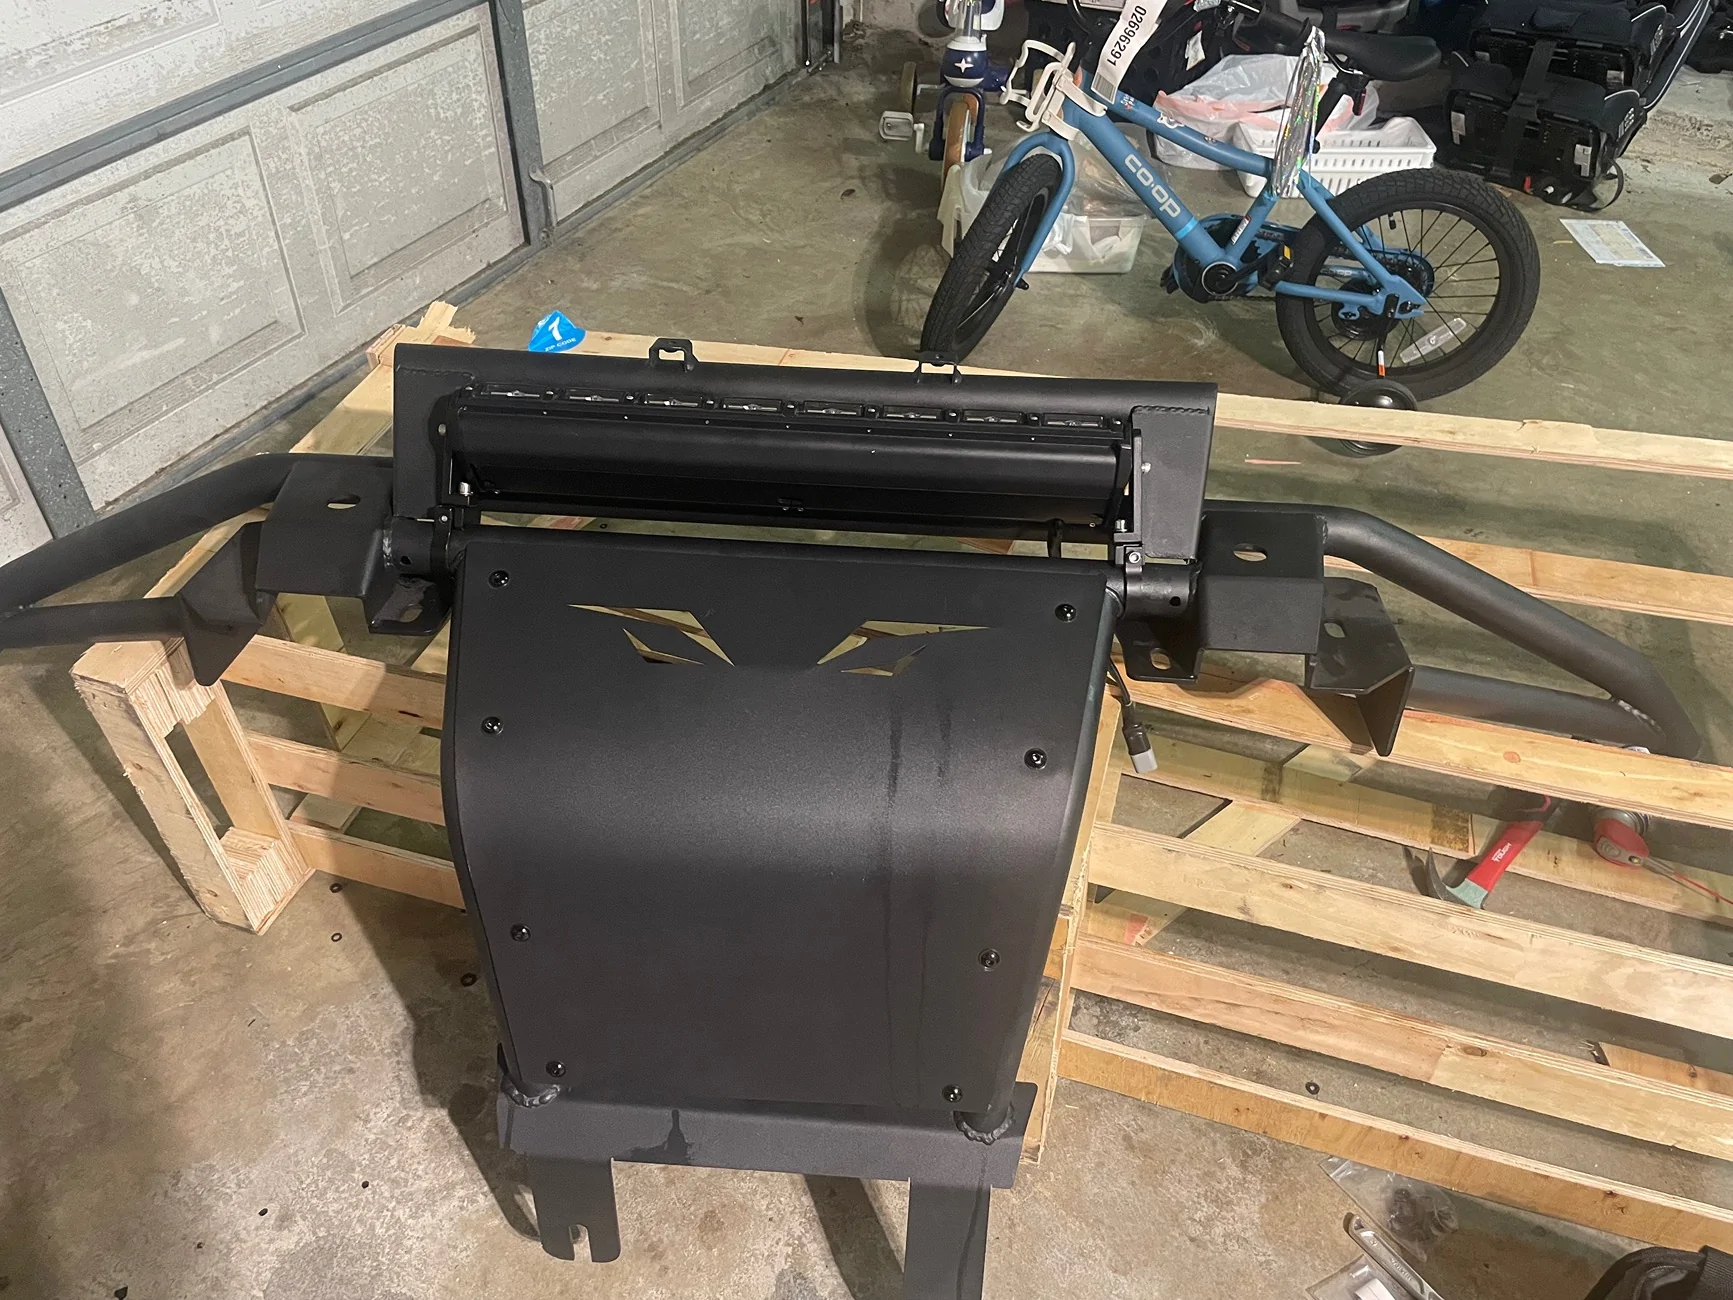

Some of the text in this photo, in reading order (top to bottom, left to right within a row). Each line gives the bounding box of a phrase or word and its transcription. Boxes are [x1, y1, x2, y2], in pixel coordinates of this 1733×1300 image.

[1107, 5, 1147, 66] 02696291
[545, 337, 577, 352] ZIP CODE
